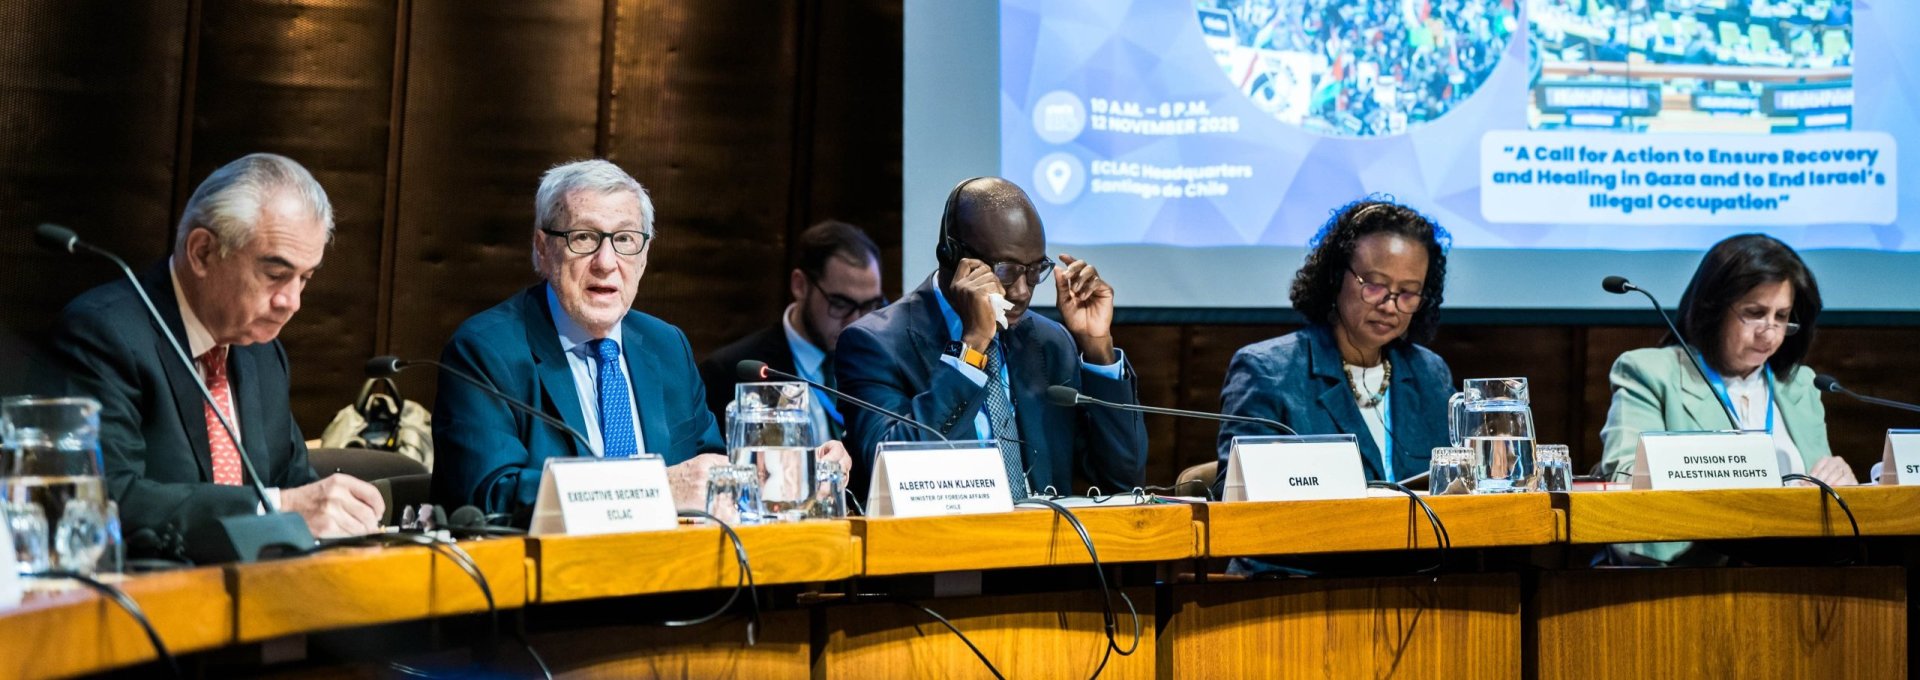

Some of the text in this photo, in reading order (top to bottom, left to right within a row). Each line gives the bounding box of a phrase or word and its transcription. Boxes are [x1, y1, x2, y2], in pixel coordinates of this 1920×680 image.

[1109, 100, 1143, 118] A.M.
[1159, 101, 1171, 118] 6
[1173, 100, 1210, 118] P.M.
[1091, 114, 1107, 130] 12
[1108, 117, 1197, 135] NOVEMBER
[1535, 146, 1575, 162] Call
[1579, 146, 1608, 163] for
[1612, 147, 1680, 163] Action
[1684, 147, 1704, 163] to
[1708, 148, 1779, 164] Ensure
[1783, 149, 1879, 167] Recovery
[1091, 159, 1253, 183] ECLAC Headquarters
[1493, 169, 1532, 184] and
[1537, 169, 1616, 190] Healing
[1622, 169, 1640, 185] in
[1645, 172, 1695, 186] Gaza
[1700, 171, 1740, 187] and
[1744, 172, 1764, 187] to
[1769, 171, 1805, 187] End
[1091, 178, 1229, 199] Santiago de Chile
[1589, 193, 1653, 213] Illegal
[1684, 455, 1747, 464] DIVISION FOR
[1288, 476, 1320, 486] CHAIR
[1668, 469, 1768, 479] PALESTINIAN RIGHTS
[900, 478, 996, 490] ALBERTO VAN KLAVEREN
[567, 488, 660, 502] EXECUTIVE SECRETARY
[606, 509, 633, 520] ECLAC
